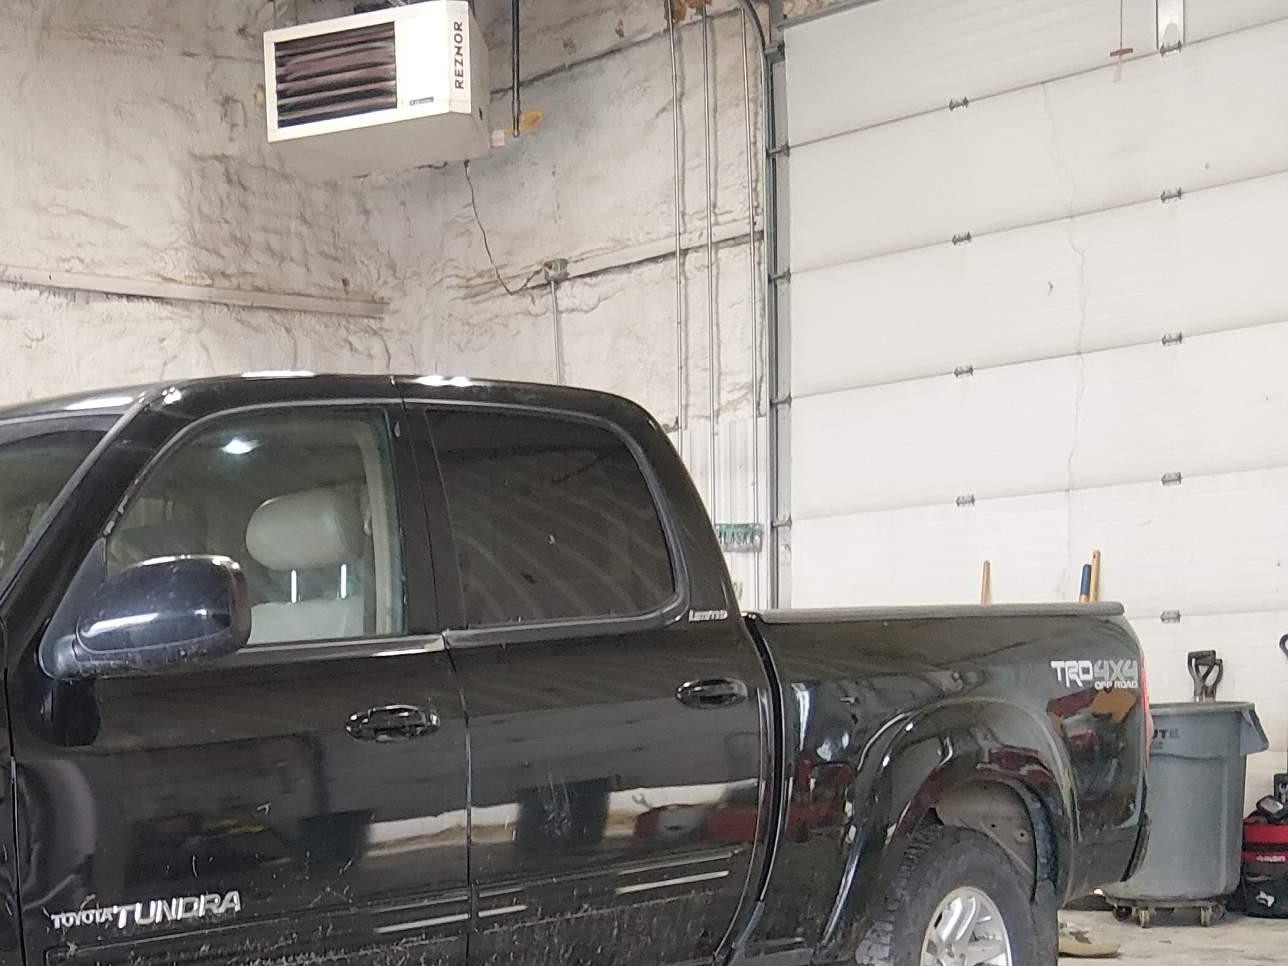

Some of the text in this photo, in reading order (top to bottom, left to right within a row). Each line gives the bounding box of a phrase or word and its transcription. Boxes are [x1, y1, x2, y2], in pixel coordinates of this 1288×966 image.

[453, 20, 465, 90] REZNOR
[1050, 659, 1093, 688] TRD
[50, 889, 242, 930] TOYOTA TUNDRA
